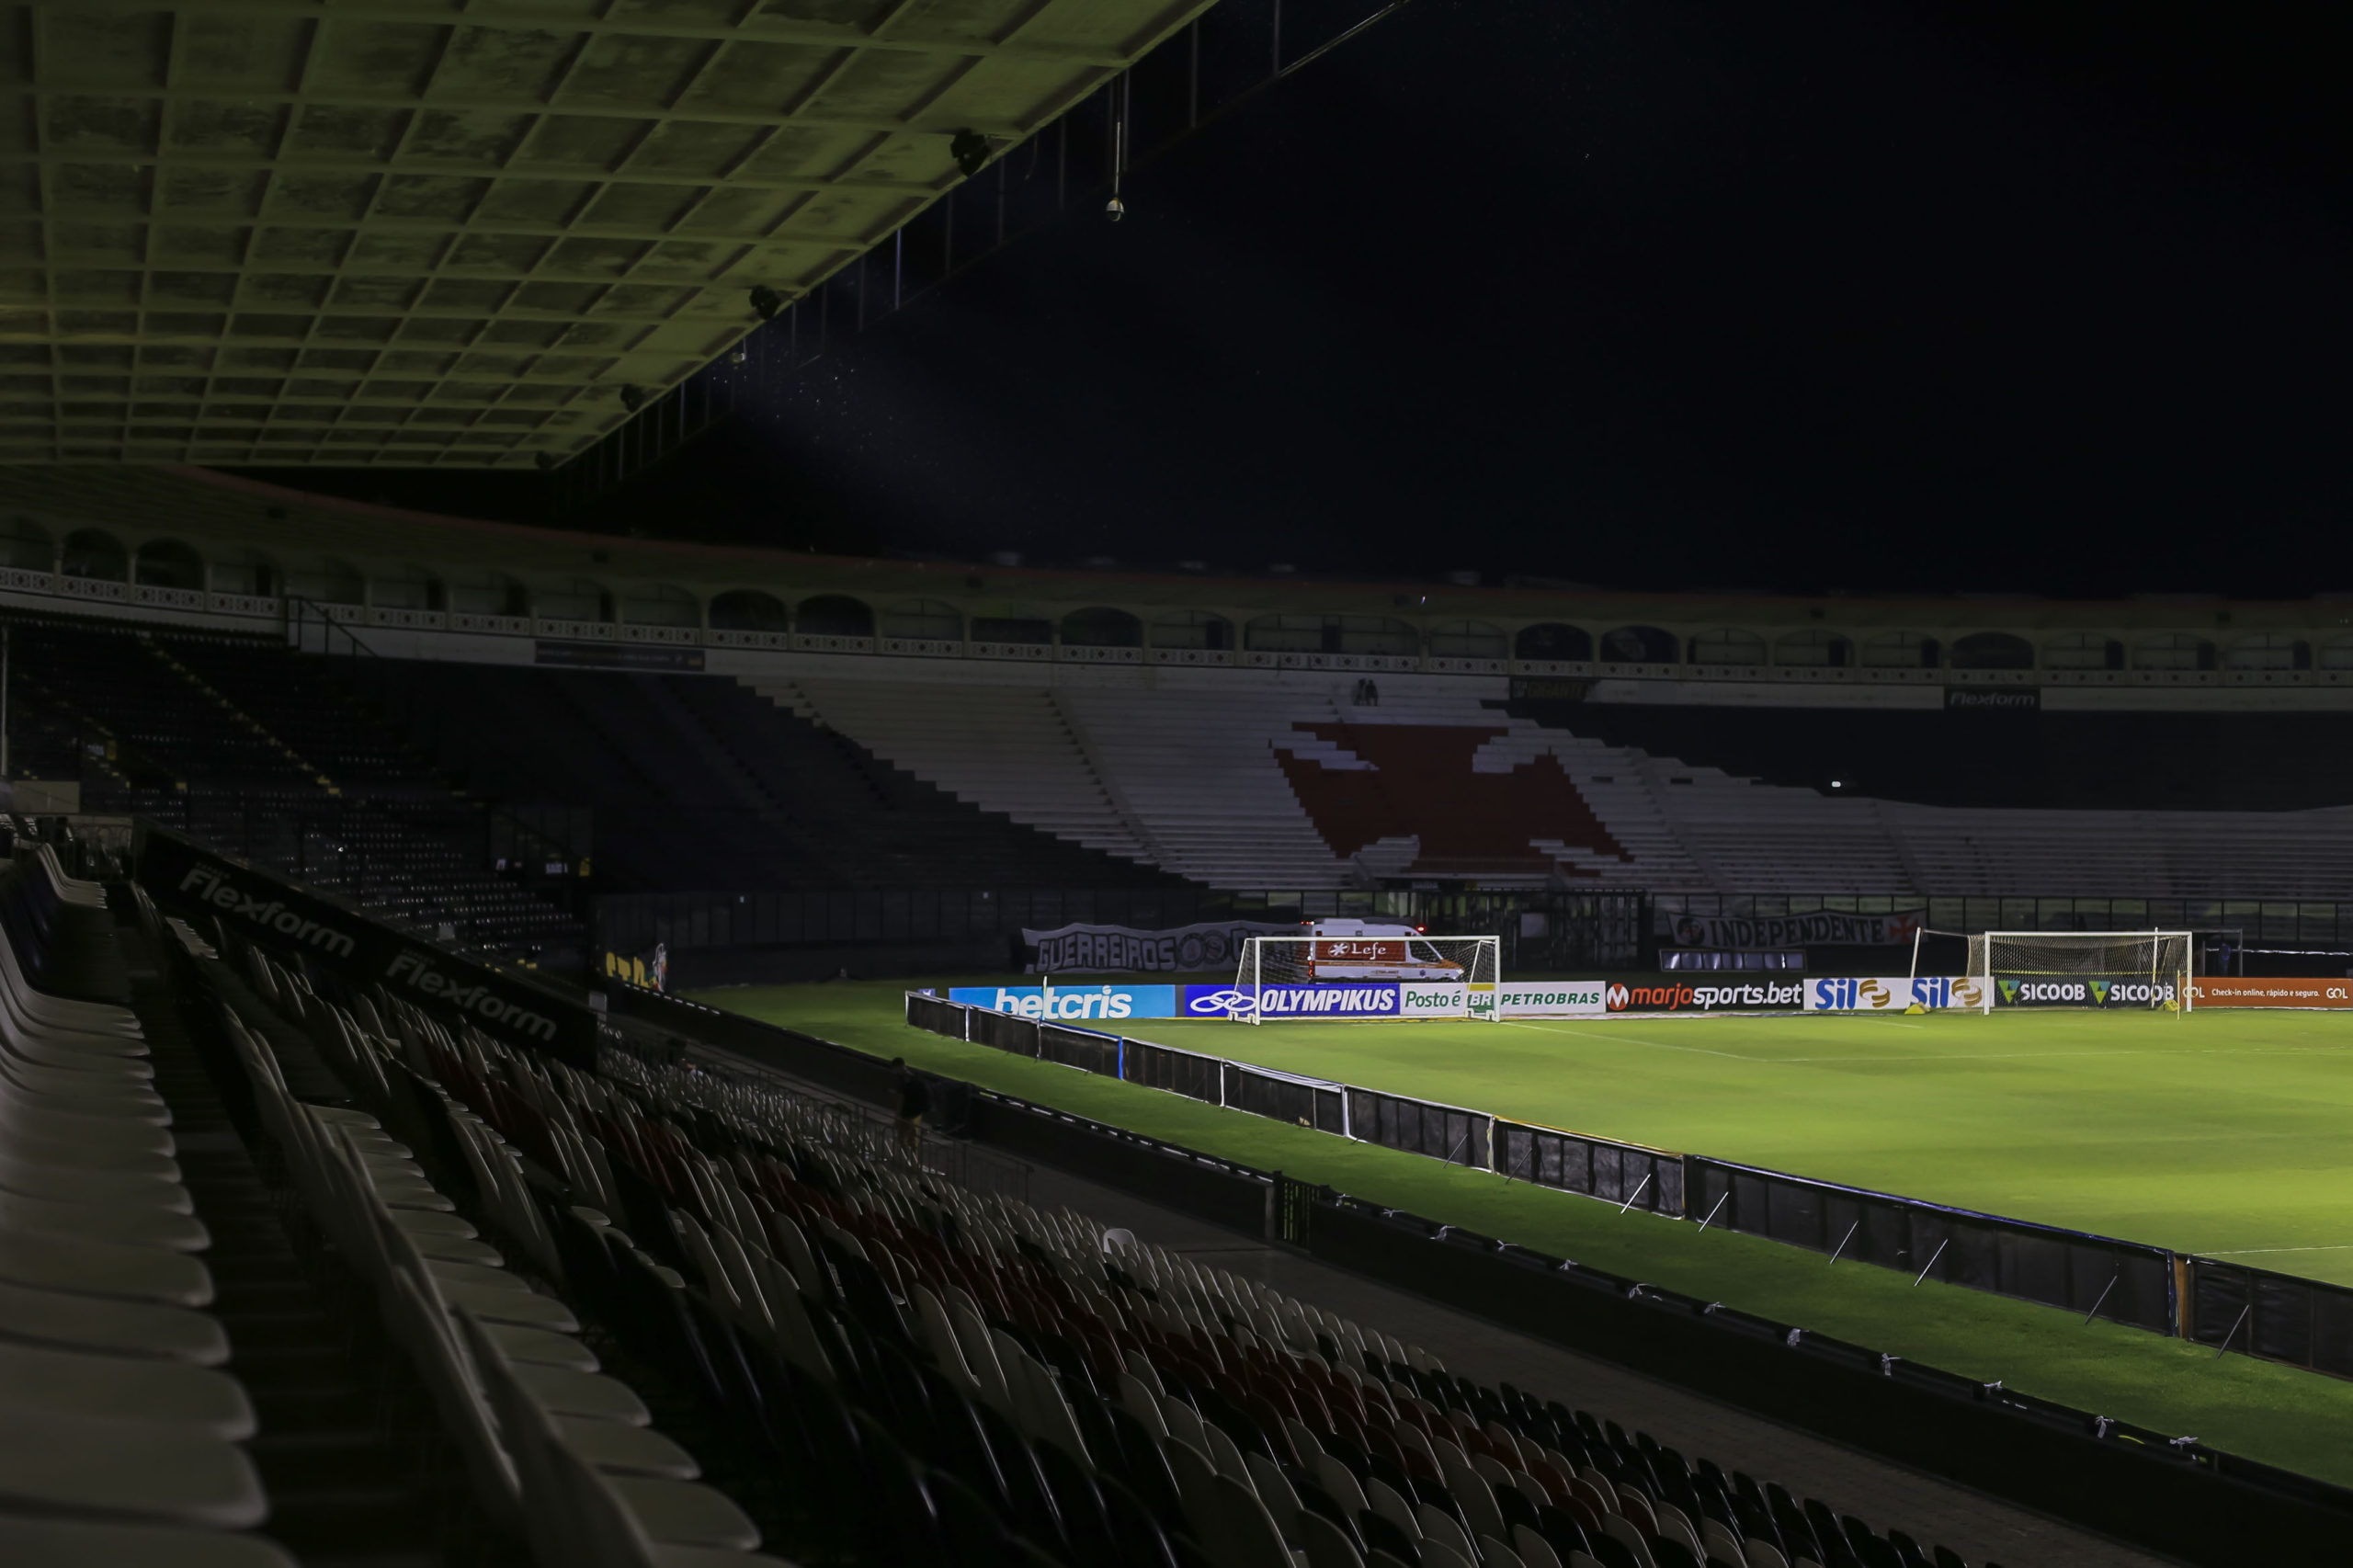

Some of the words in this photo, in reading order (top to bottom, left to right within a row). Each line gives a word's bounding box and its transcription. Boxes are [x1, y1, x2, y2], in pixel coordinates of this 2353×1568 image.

[1949, 691, 2036, 707] Flexform
[178, 867, 356, 959] Flexform
[1709, 917, 1884, 948] INDEPENDENTE
[1035, 932, 1177, 972] GUERREIROS
[385, 955, 557, 1041] Flexform
[995, 985, 1132, 1019] betcris
[1261, 988, 1397, 1012] OLYMPIKUS
[1404, 990, 1449, 1008] Posto
[1451, 990, 1461, 1007] é
[1469, 994, 1492, 1006] BR
[1500, 992, 1601, 1006] PETROBRAS
[1630, 982, 1803, 1011] marjosports.bet
[1814, 979, 1857, 1009] Sil
[1910, 977, 1949, 1008] Sil
[2020, 983, 2086, 1002] SICOOB
[2109, 984, 2175, 1002] SICOOB
[2211, 988, 2242, 997] Check-in
[2243, 988, 2266, 998] online,
[2267, 987, 2289, 998] rápido
[2295, 990, 2321, 999] seguro.
[2325, 987, 2349, 999] GOL
